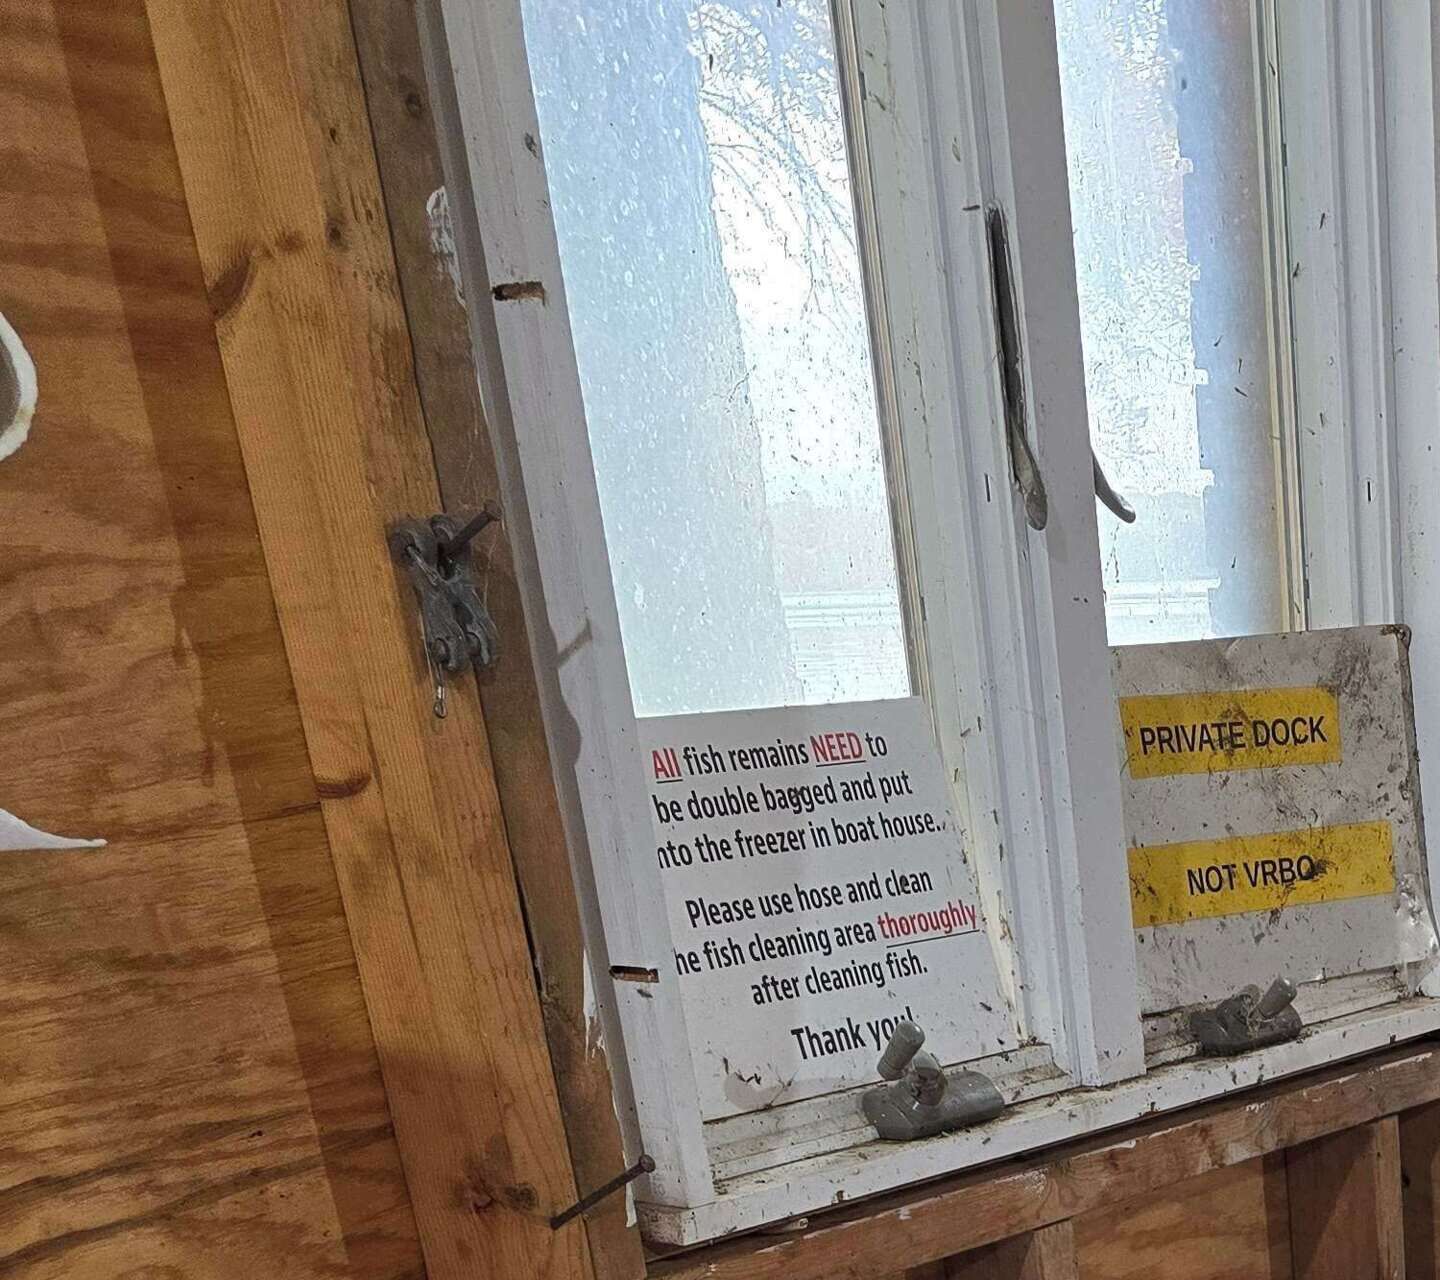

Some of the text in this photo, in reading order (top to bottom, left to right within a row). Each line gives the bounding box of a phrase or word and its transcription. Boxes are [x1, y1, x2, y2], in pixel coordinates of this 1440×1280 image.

[652, 732, 888, 779] All fish remains NEED to
[1140, 715, 1328, 755] PRIVATE DOCK
[652, 770, 913, 823] be double bagged and put
[657, 811, 941, 869] nto the freezer in boat house.
[685, 869, 933, 928] Please use hose and clean
[1186, 855, 1316, 896] NOT VRBO
[673, 899, 977, 975] he fish cleaning area thoroughly
[751, 949, 928, 1005] after cleaning fish.
[791, 1017, 866, 1060] Thank
